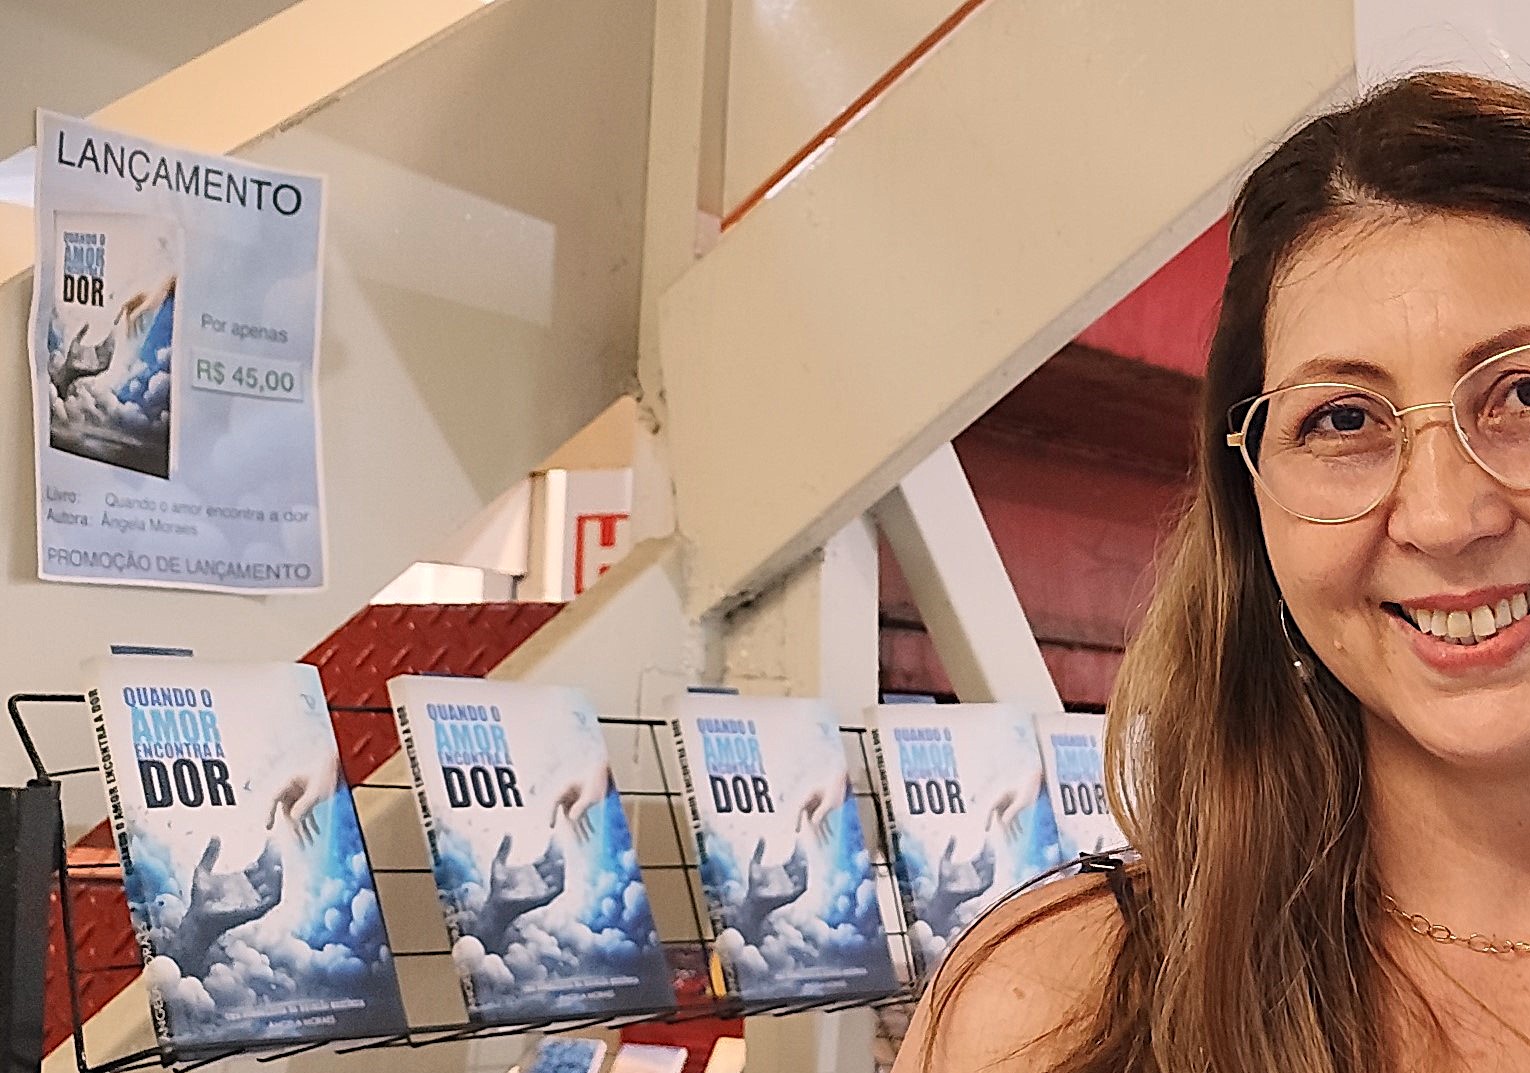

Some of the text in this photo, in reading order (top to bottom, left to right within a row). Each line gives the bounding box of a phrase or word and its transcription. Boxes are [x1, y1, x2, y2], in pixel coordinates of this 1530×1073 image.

[58, 130, 303, 217] LANÇAMENTO
[63, 274, 104, 307] DOR
[201, 313, 288, 343] Por apenas
[197, 358, 295, 392] R$ 45,00
[104, 491, 157, 512] Quando
[171, 502, 200, 515] amor
[206, 505, 265, 523] encontra
[269, 511, 279, 522] a
[283, 508, 309, 523] dor
[47, 547, 312, 581] PROMOÇÃO DE LANÇAMENTO
[88, 688, 101, 714] DOR
[123, 687, 213, 709] QUANDO O
[427, 703, 501, 722] QUANDO O
[131, 706, 223, 744] AMOR
[435, 724, 508, 754] AMOR
[95, 724, 117, 785] ENCONTRA
[135, 742, 226, 760] ENCONTRA A
[138, 758, 237, 809] DOR
[442, 765, 525, 808] DOR
[709, 774, 776, 814] DOR
[904, 779, 967, 816] DOR
[1060, 783, 1110, 817] DOR
[108, 785, 123, 821] AMOR
